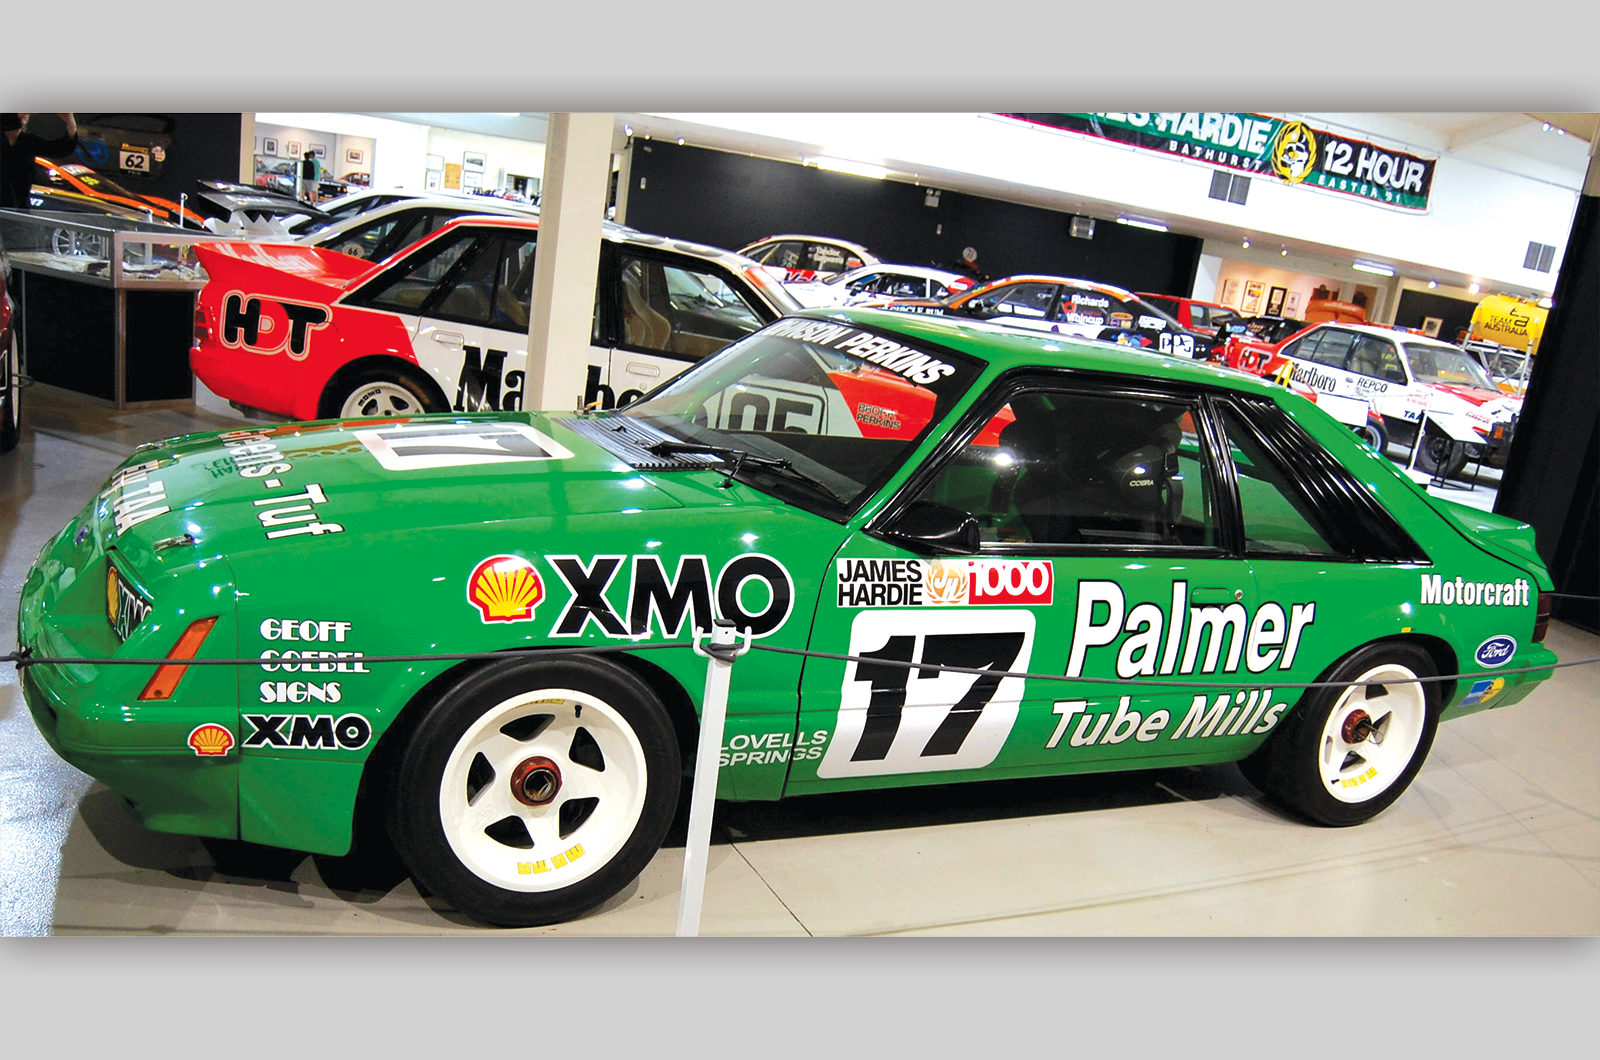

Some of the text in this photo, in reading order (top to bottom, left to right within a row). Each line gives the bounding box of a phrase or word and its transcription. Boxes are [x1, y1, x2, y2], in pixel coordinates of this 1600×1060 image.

[125, 154, 145, 169] 62
[1169, 140, 1263, 170] BATHURST
[1324, 140, 1425, 192] 12 HOUR
[1318, 174, 1378, 198] EASTER
[1071, 294, 1109, 308] Richards
[220, 290, 333, 361] HDT
[1484, 321, 1528, 337] AUSTRALIA
[1490, 315, 1512, 326] TEAM
[833, 330, 955, 385] PERKINS
[1357, 376, 1388, 393] REPCO
[856, 412, 901, 430] PERKINS
[839, 559, 922, 583] JAMES
[968, 560, 1050, 597] 1000
[544, 552, 795, 639] XMO
[838, 583, 923, 606] HARDIE
[1420, 573, 1529, 607] Motorcraft
[259, 618, 352, 642] GEOFF
[1064, 579, 1317, 680] Palmer
[1481, 642, 1511, 659] Ford
[259, 681, 342, 703] SIGNS
[850, 632, 1025, 763] 17
[1044, 688, 1288, 749] Tube Mills
[241, 713, 372, 750] XMO
[719, 747, 823, 767] SPRINGS
